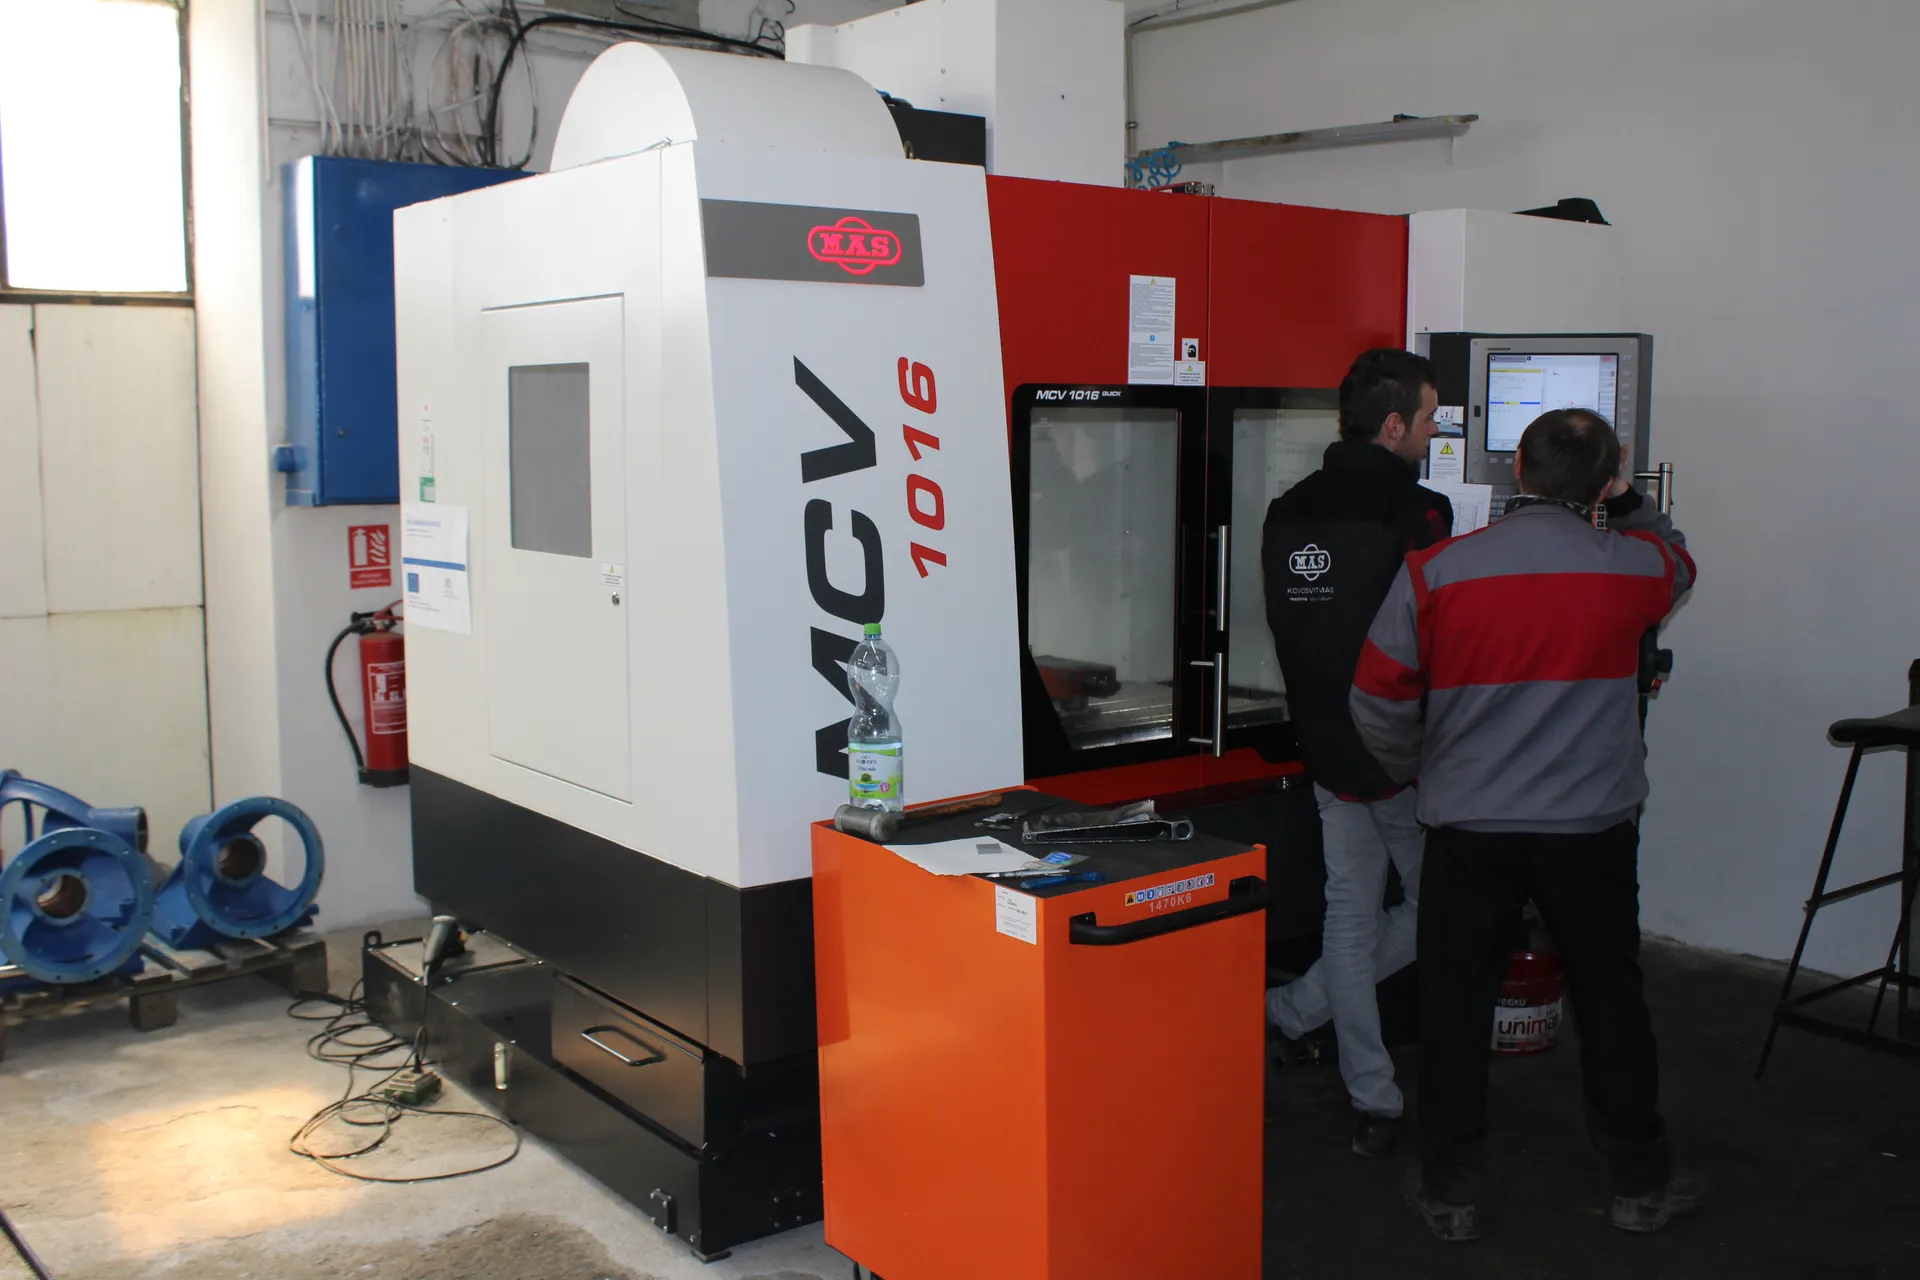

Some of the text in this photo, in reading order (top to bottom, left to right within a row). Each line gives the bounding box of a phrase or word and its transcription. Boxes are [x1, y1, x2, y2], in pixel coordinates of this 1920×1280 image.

[820, 233, 890, 258] MAS
[1036, 390, 1067, 400] MCV
[1069, 391, 1099, 400] 1016
[898, 357, 947, 578] 1016
[793, 355, 889, 783] MCV
[1295, 555, 1325, 569] MAS
[1149, 893, 1192, 912] 1470K6
